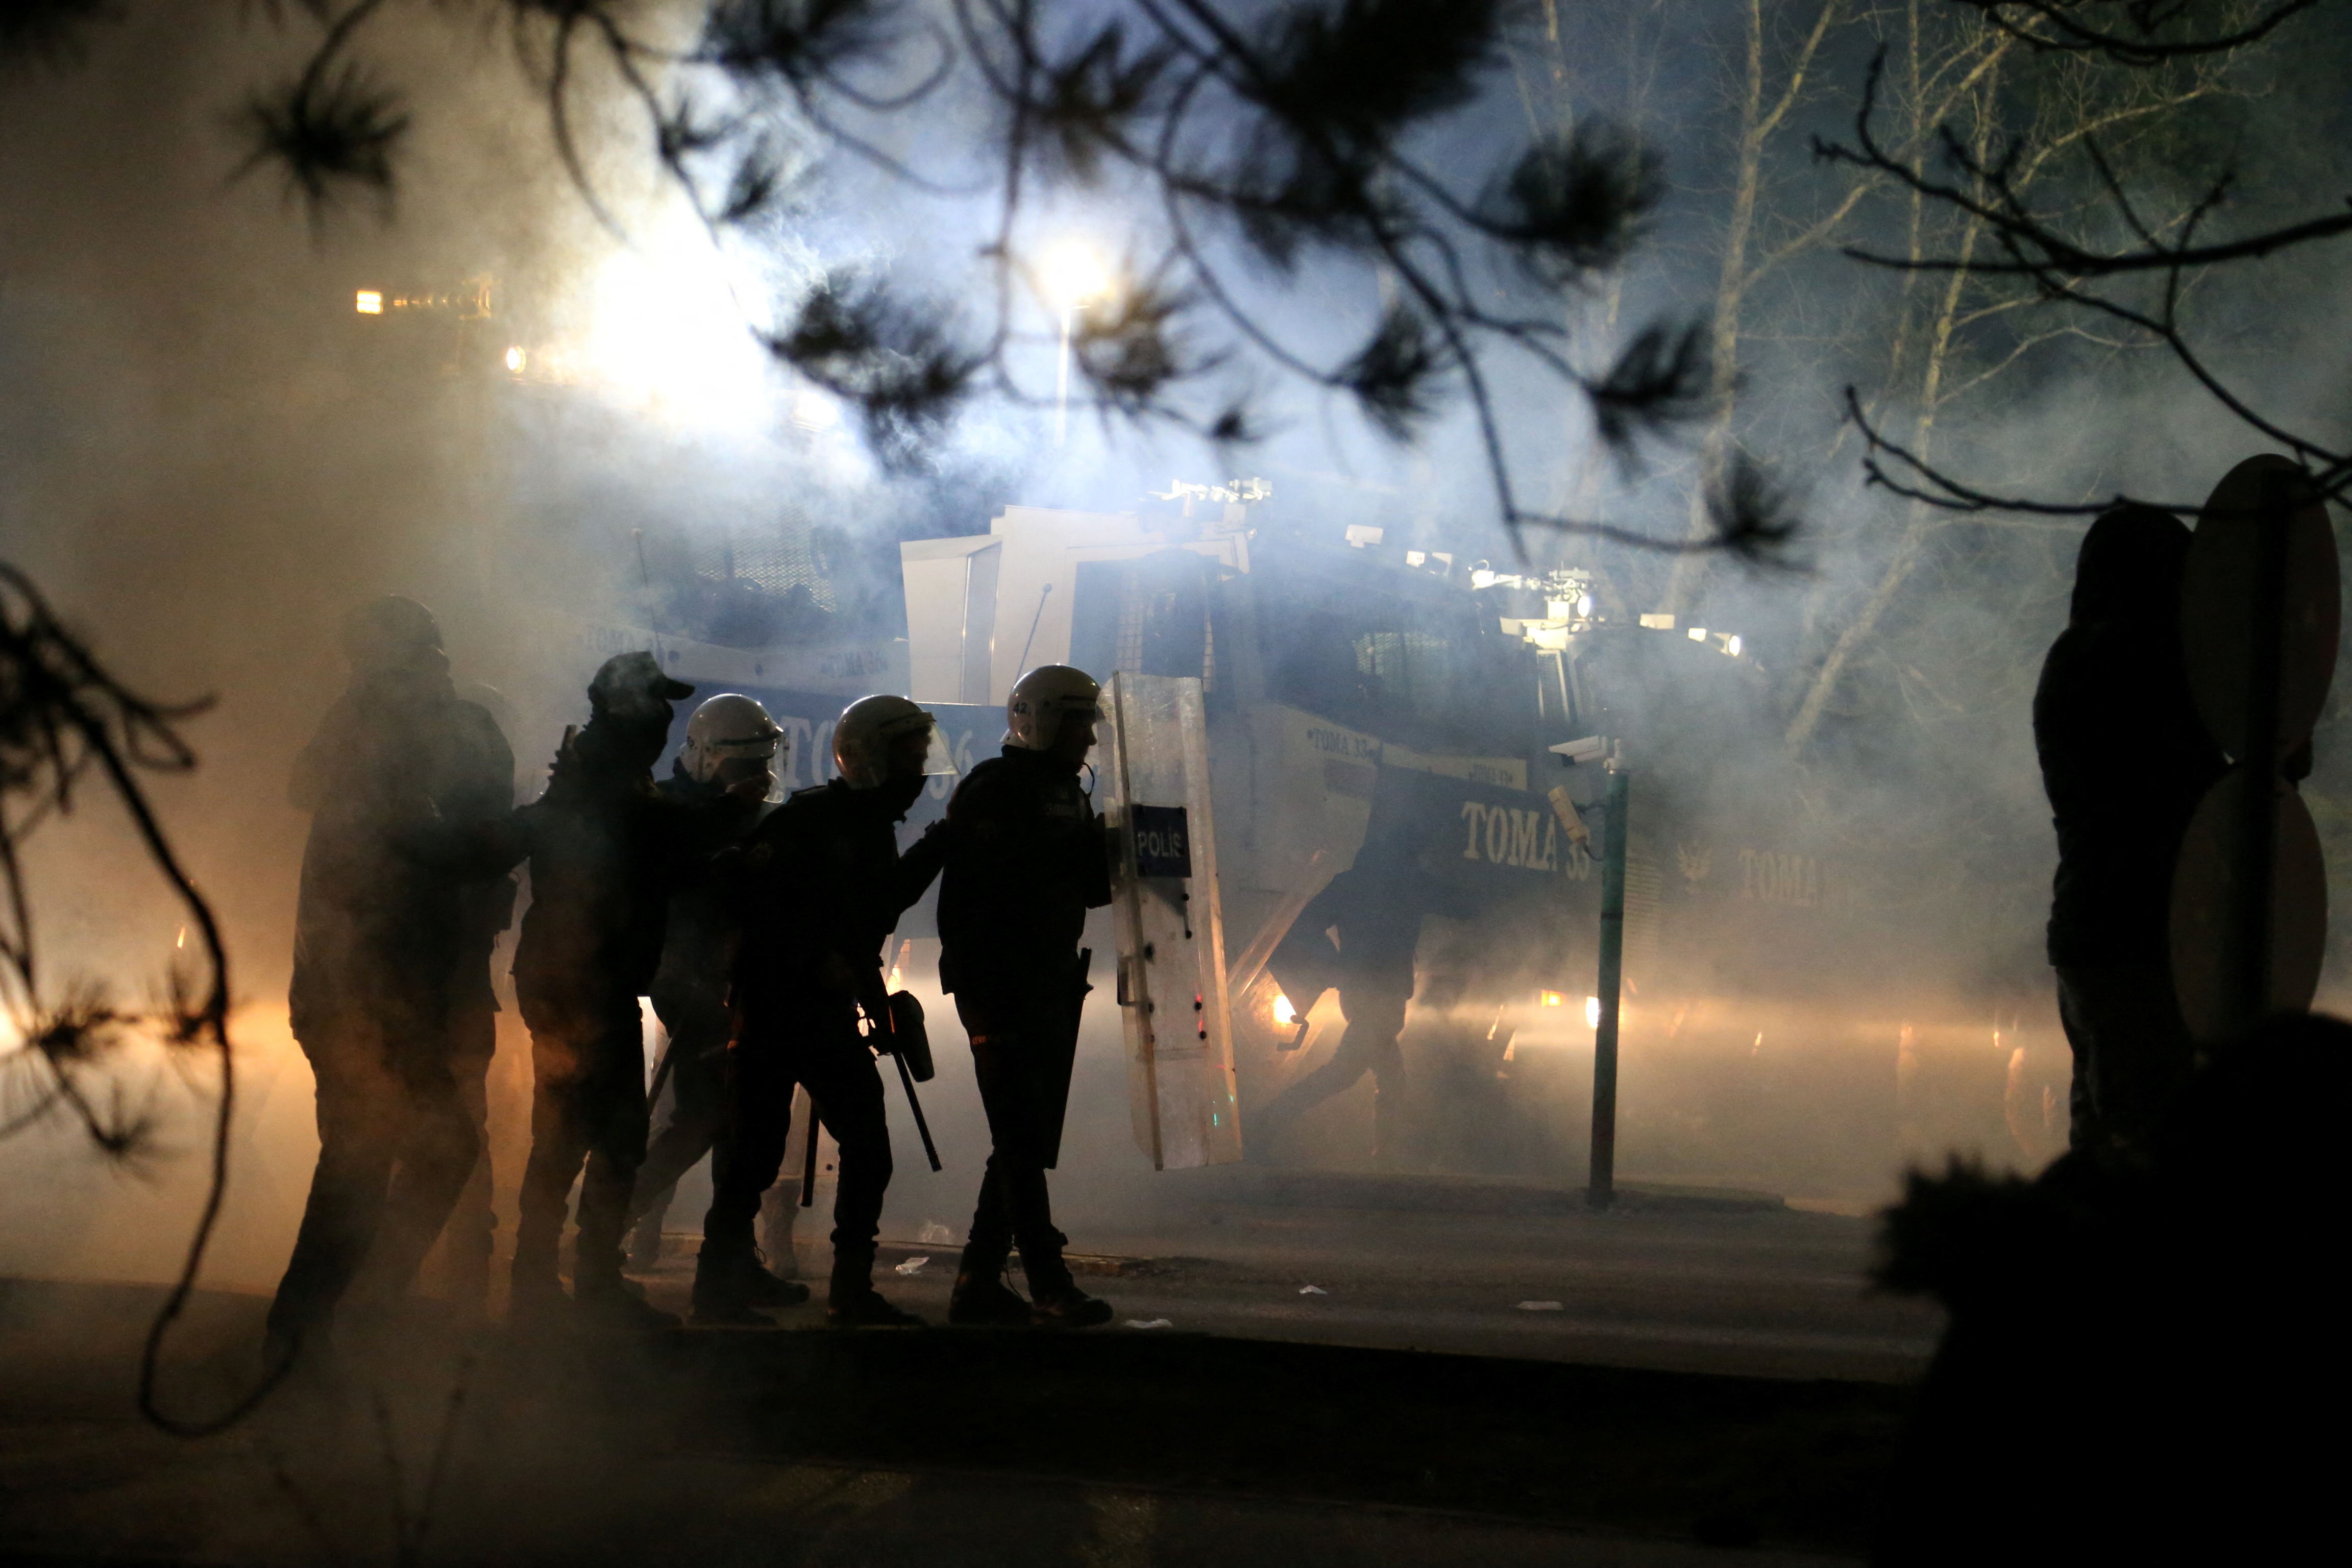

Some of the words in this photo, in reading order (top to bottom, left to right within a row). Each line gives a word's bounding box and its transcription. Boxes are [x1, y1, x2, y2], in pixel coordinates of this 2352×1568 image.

[1013, 702, 1028, 714] 42
[1313, 728, 1349, 756] TOMA
[1137, 826, 1183, 858] POLİS
[1460, 801, 1558, 872] TOMA
[1737, 848, 1818, 908] TOMA
